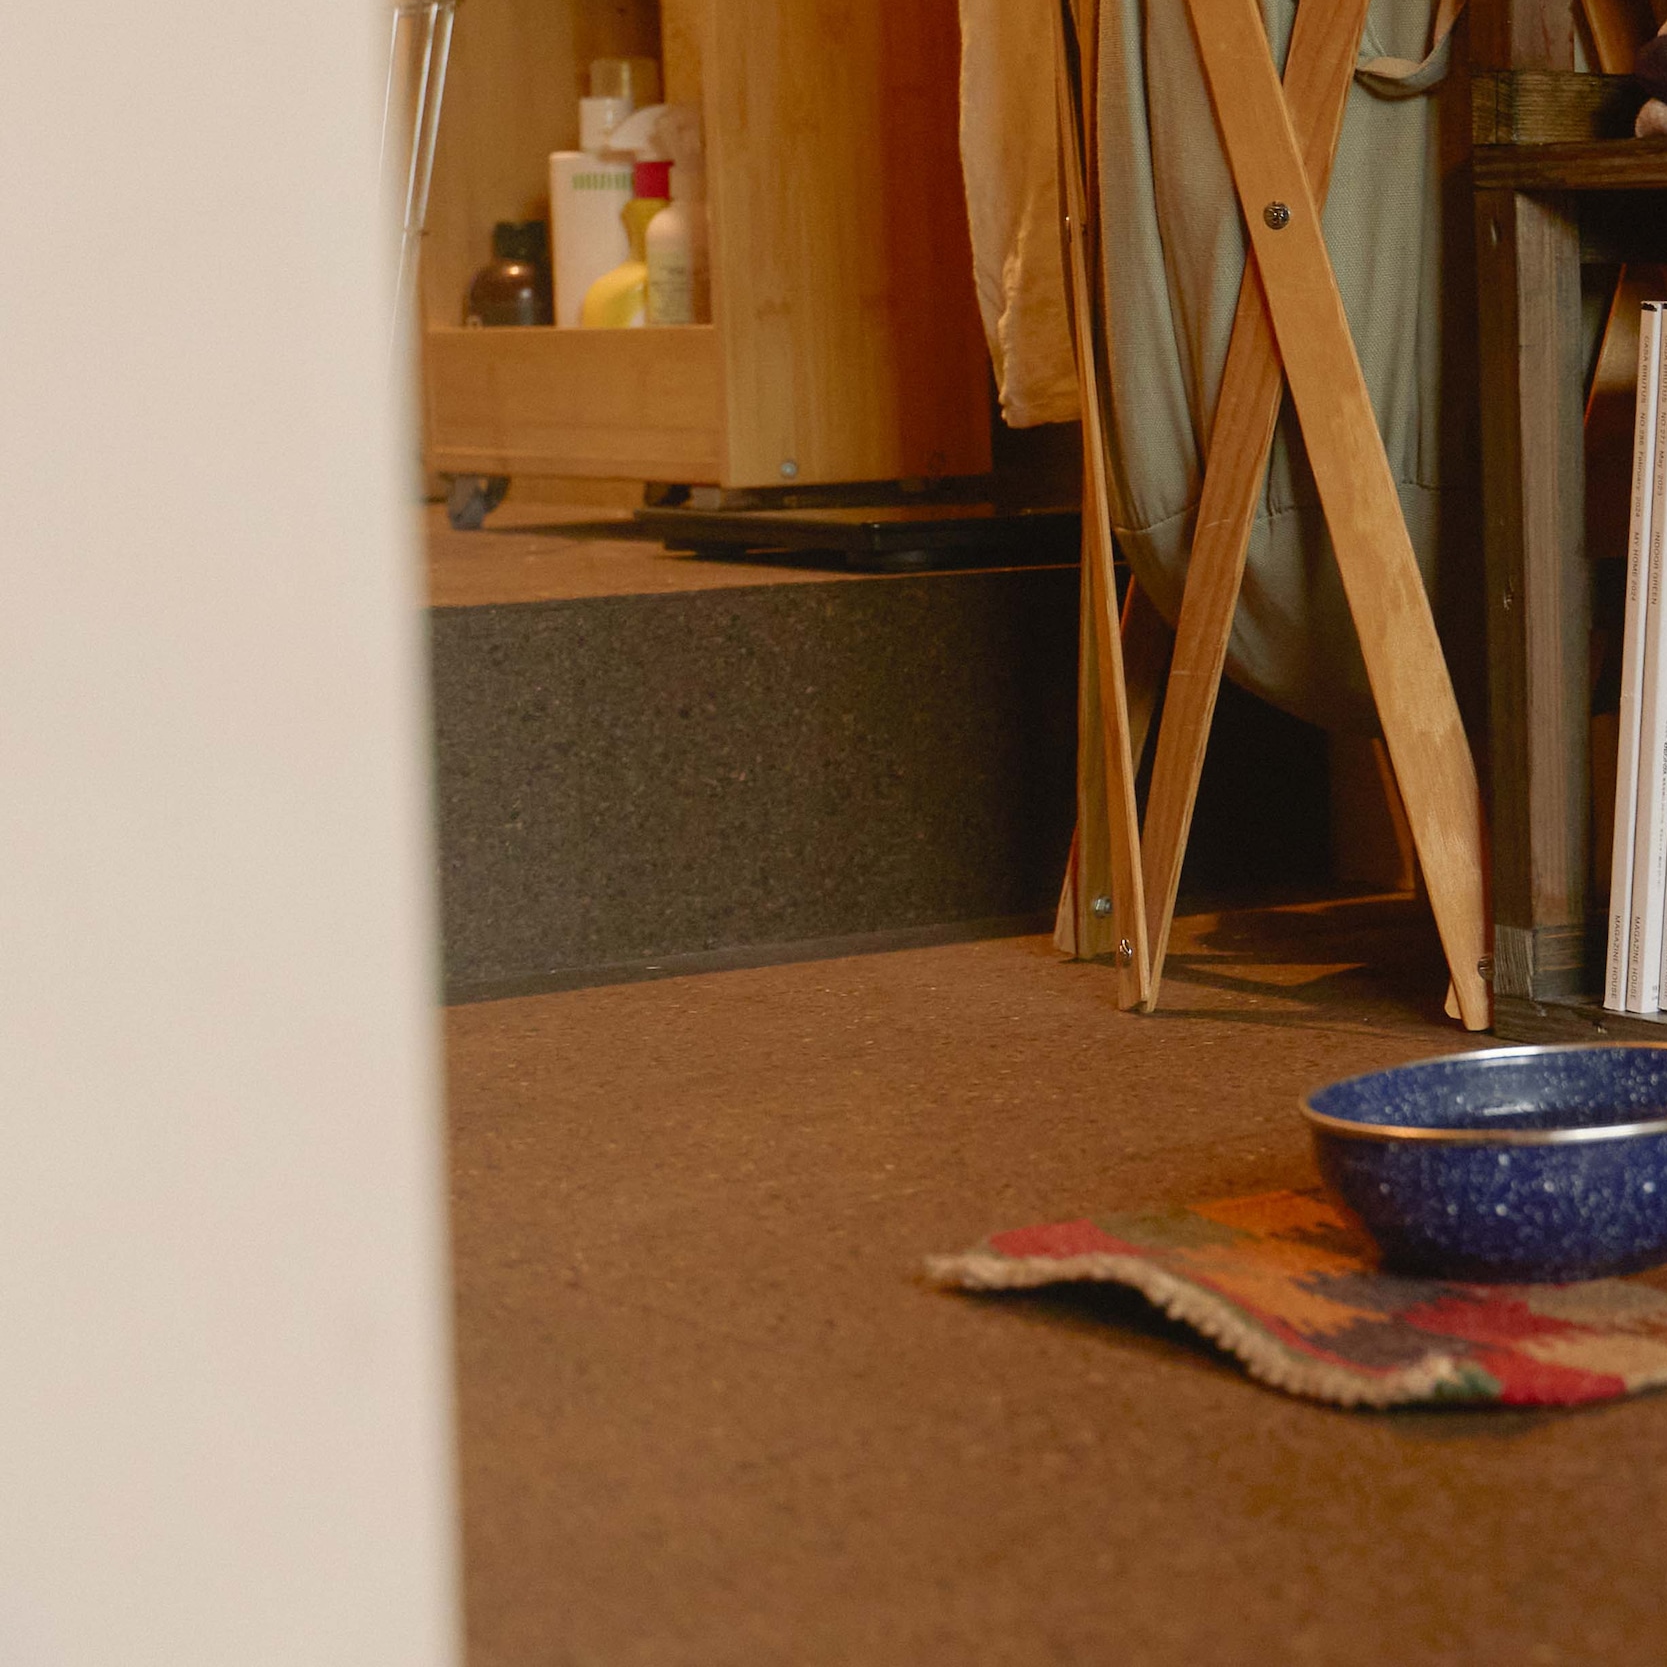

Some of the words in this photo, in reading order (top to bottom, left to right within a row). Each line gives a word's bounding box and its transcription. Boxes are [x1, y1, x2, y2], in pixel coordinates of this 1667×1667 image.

[1641, 335, 1650, 362] CASA
[1640, 364, 1649, 404] BRUTUS
[1634, 451, 1645, 491] February
[1656, 450, 1665, 469] May
[1633, 532, 1640, 546] MY
[1631, 548, 1640, 578] HOME
[1612, 914, 1622, 965] MAGAZINE
[1631, 915, 1641, 966] MAGAZINE
[1610, 966, 1618, 1000] HOUSE
[1629, 967, 1638, 1000] HOUSE
